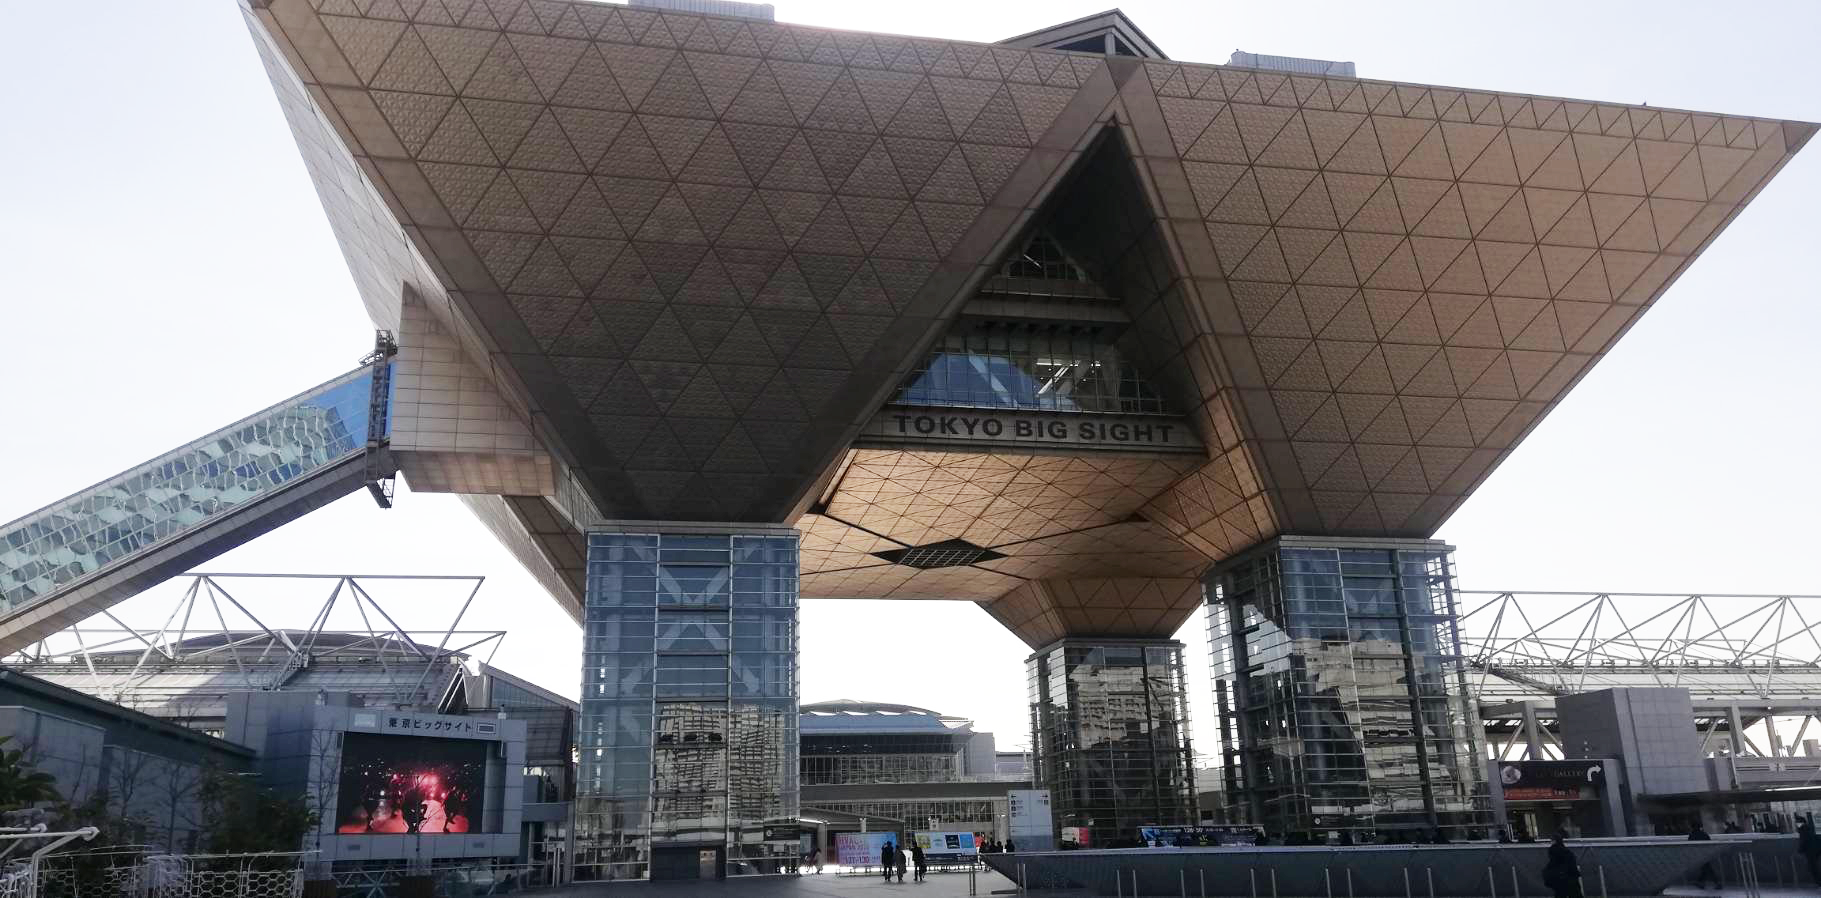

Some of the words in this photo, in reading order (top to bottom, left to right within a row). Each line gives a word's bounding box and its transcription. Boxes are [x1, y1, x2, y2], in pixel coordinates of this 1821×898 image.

[893, 414, 1003, 437] TOKYO
[1015, 418, 1068, 440] BIG
[1079, 421, 1175, 443] SIGHT
[388, 717, 473, 733] 東京ビッグサイト
